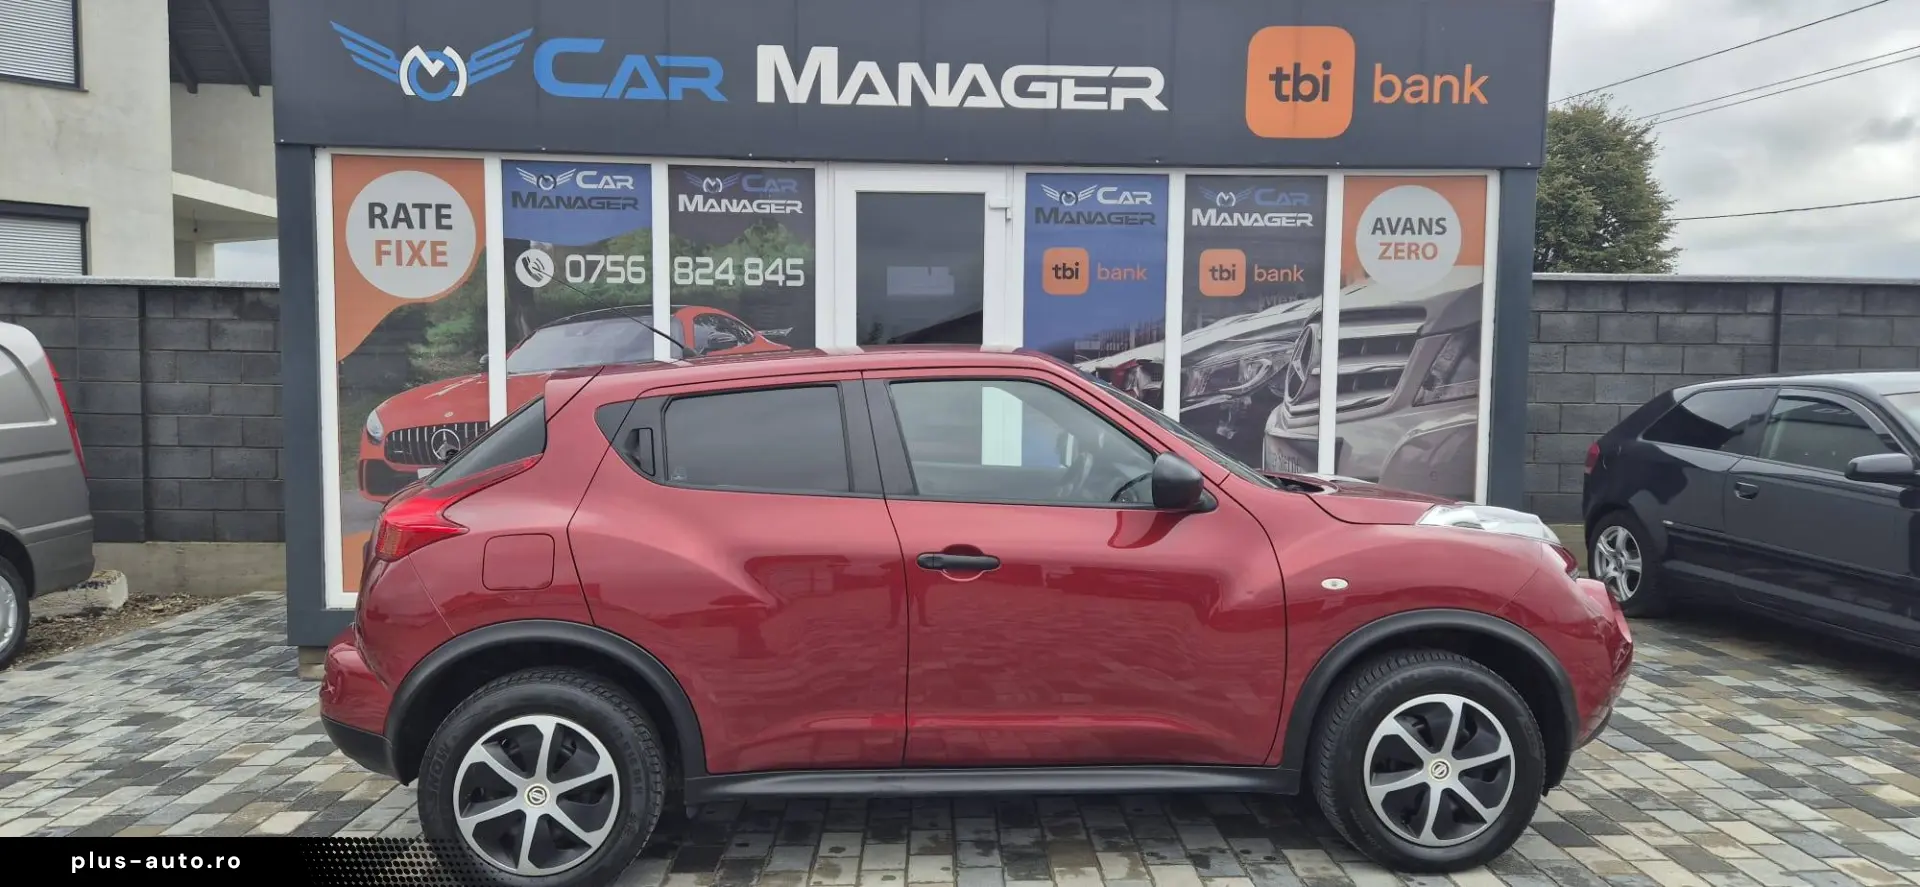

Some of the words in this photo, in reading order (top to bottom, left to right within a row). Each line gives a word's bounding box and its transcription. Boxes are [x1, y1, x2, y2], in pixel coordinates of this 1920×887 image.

[533, 38, 728, 102] CAR
[757, 45, 1168, 111] MANAGER
[1269, 60, 1331, 103] tbi
[1373, 63, 1489, 104] bank
[576, 170, 634, 190] CAR
[511, 191, 639, 210] MANAGER
[678, 194, 804, 214] MANAGER
[1097, 186, 1152, 205] CAR
[368, 201, 453, 230] RATE
[1035, 207, 1156, 226] MANAGER
[1192, 208, 1314, 227] MANAGER
[1370, 216, 1448, 237] AVANS
[374, 240, 449, 267] FIXE
[1377, 241, 1439, 262] ZERO
[565, 254, 646, 284] 0756
[673, 256, 735, 286] 824
[744, 258, 805, 288] 845
[1052, 262, 1080, 281] tbi
[1096, 263, 1147, 281] bank
[1208, 263, 1237, 282] tbi
[1254, 264, 1304, 282] bank
